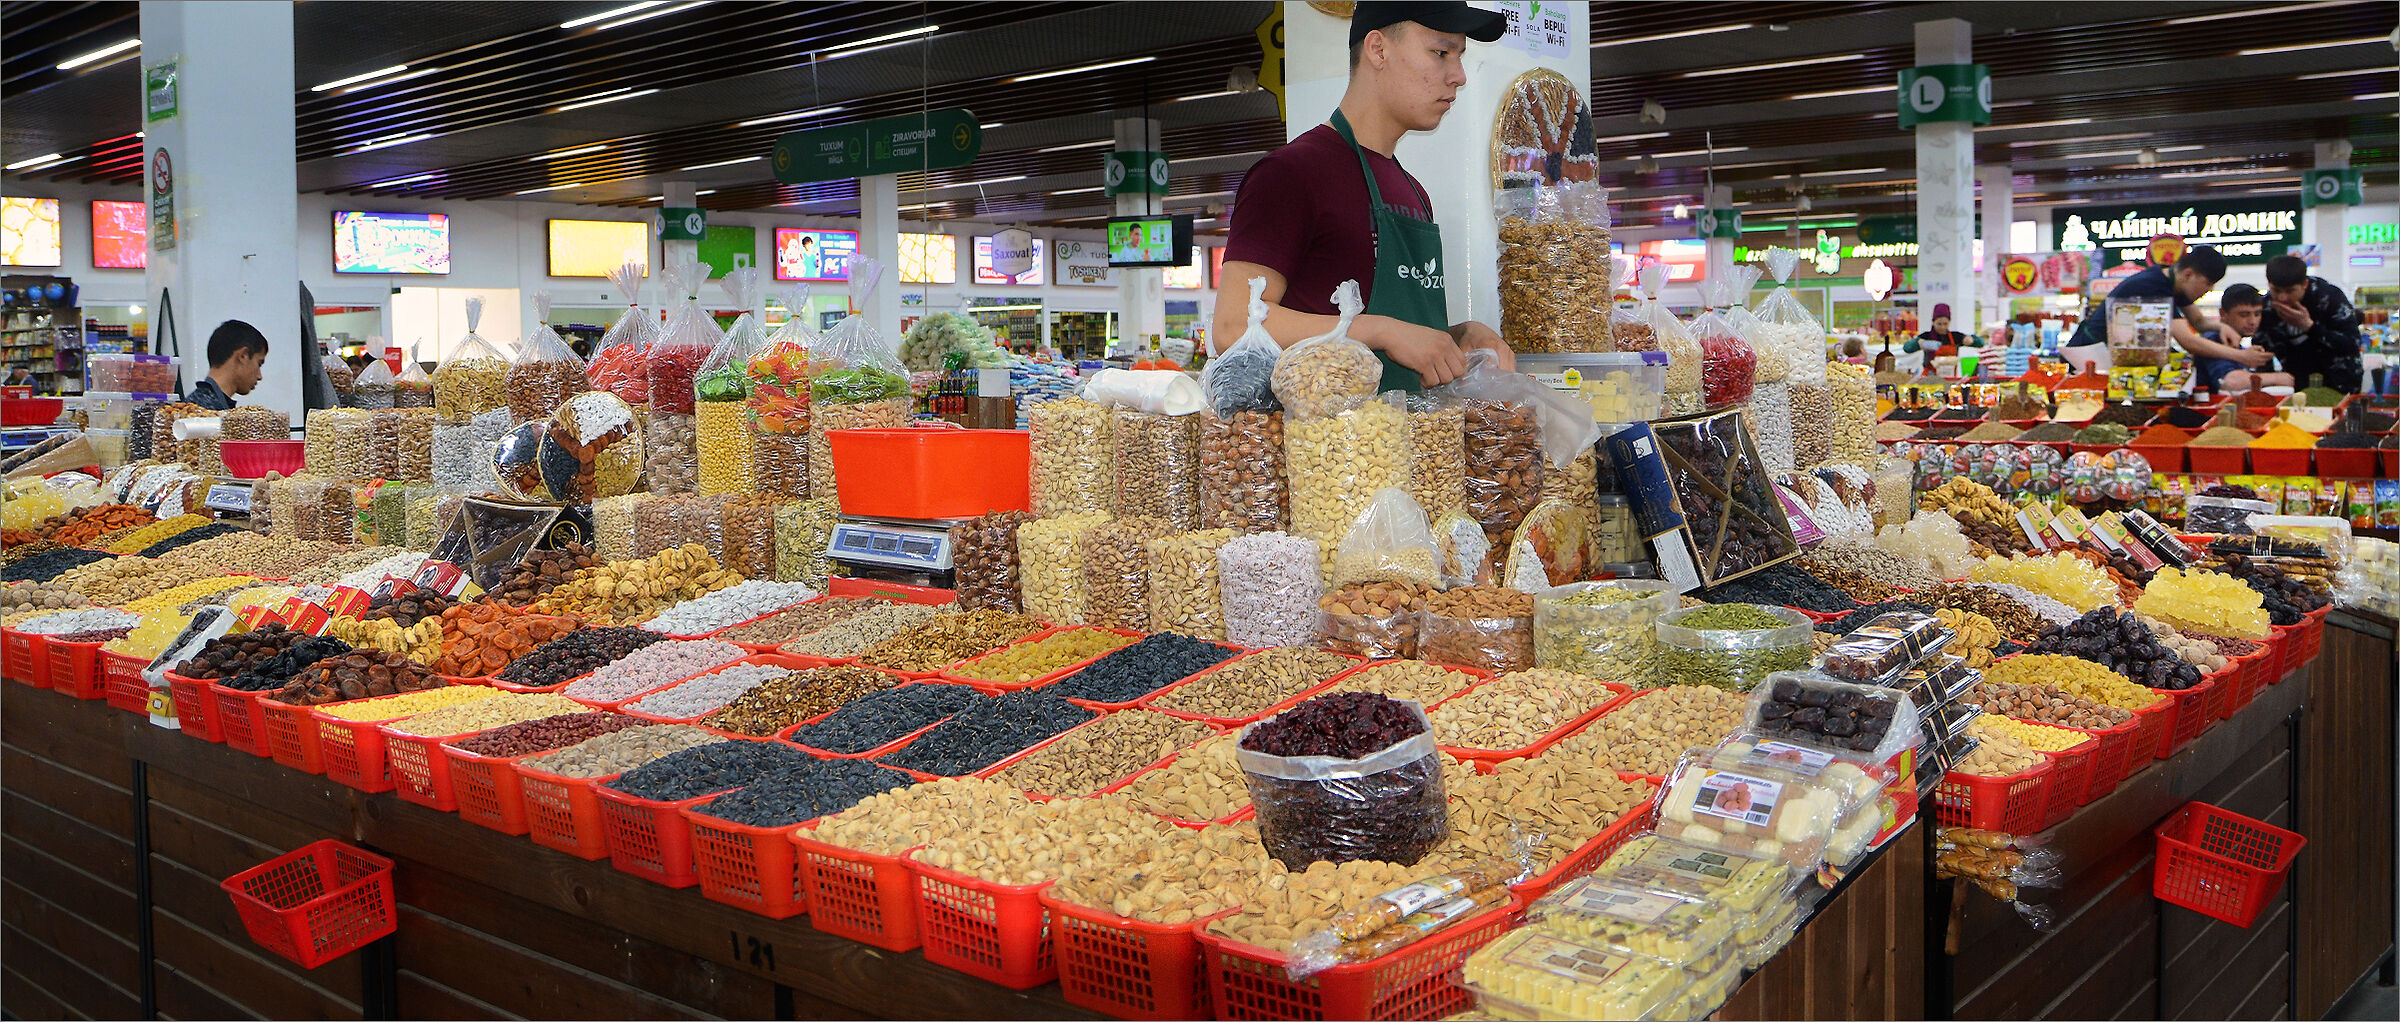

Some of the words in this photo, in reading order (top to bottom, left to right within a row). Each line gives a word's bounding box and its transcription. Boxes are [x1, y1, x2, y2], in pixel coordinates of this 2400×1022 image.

[1502, 9, 1519, 22] FREE
[1526, 24, 1541, 32] SOLA
[1544, 19, 1566, 34] BEPUL
[1546, 33, 1565, 47] Wi-Fi
[1920, 84, 1933, 105] L
[820, 141, 844, 151] TUXUM
[893, 147, 917, 157] СПЕЦИИ
[1156, 164, 1165, 180] K
[690, 217, 699, 230] K
[2091, 207, 2198, 239] ЧАЙНЫЙ
[2201, 210, 2296, 237] ДОМИК
[994, 247, 1029, 260] Saxovat
[2222, 242, 2262, 256] КОФЕ
[1069, 266, 1108, 280] TOSHKENT
